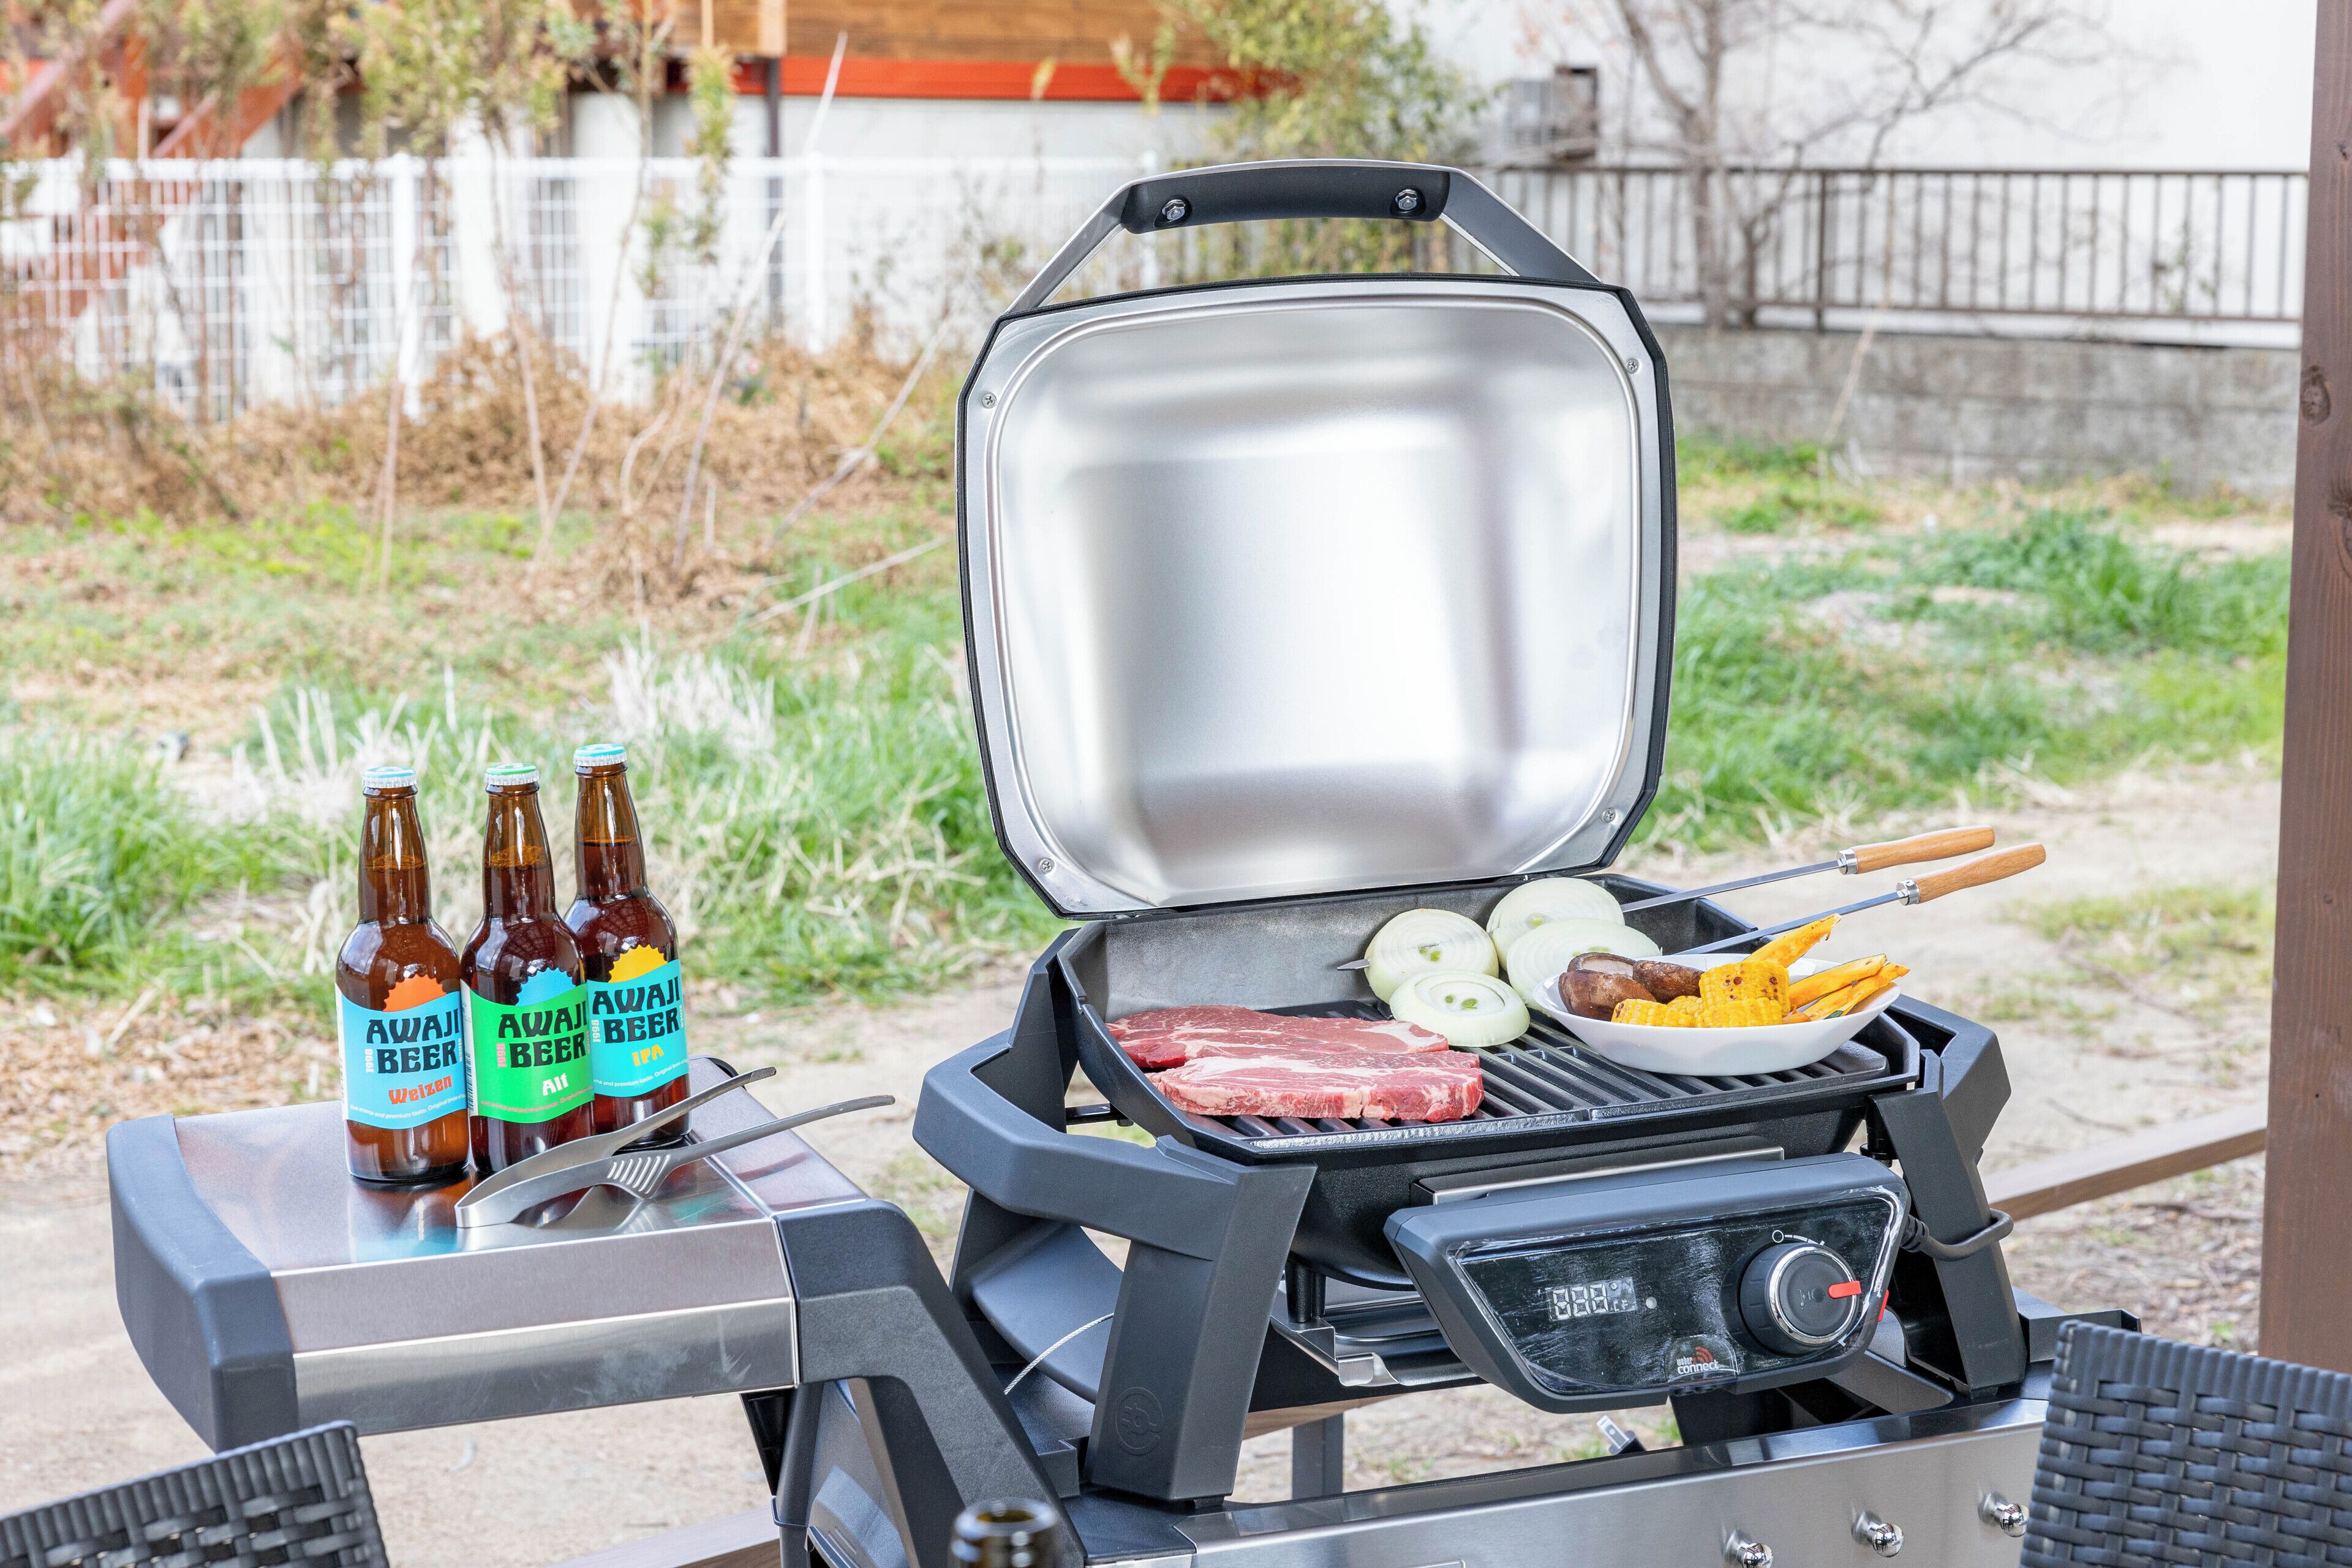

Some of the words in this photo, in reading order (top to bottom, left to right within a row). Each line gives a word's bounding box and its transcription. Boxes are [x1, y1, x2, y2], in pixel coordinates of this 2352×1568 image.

[592, 976, 680, 1014] AWAJI
[366, 1009, 459, 1044] AWAJI
[499, 1001, 587, 1038] AWAJI
[591, 1019, 601, 1044] 1998
[603, 1008, 679, 1044] BEER
[377, 1040, 458, 1074] BEER
[510, 1032, 586, 1068] BEER
[632, 1044, 665, 1066] IPA
[388, 1076, 452, 1104] Weizen
[542, 1073, 568, 1096] Alt
[1676, 1356, 1692, 1366] weber
[1678, 1359, 1719, 1374] connect
